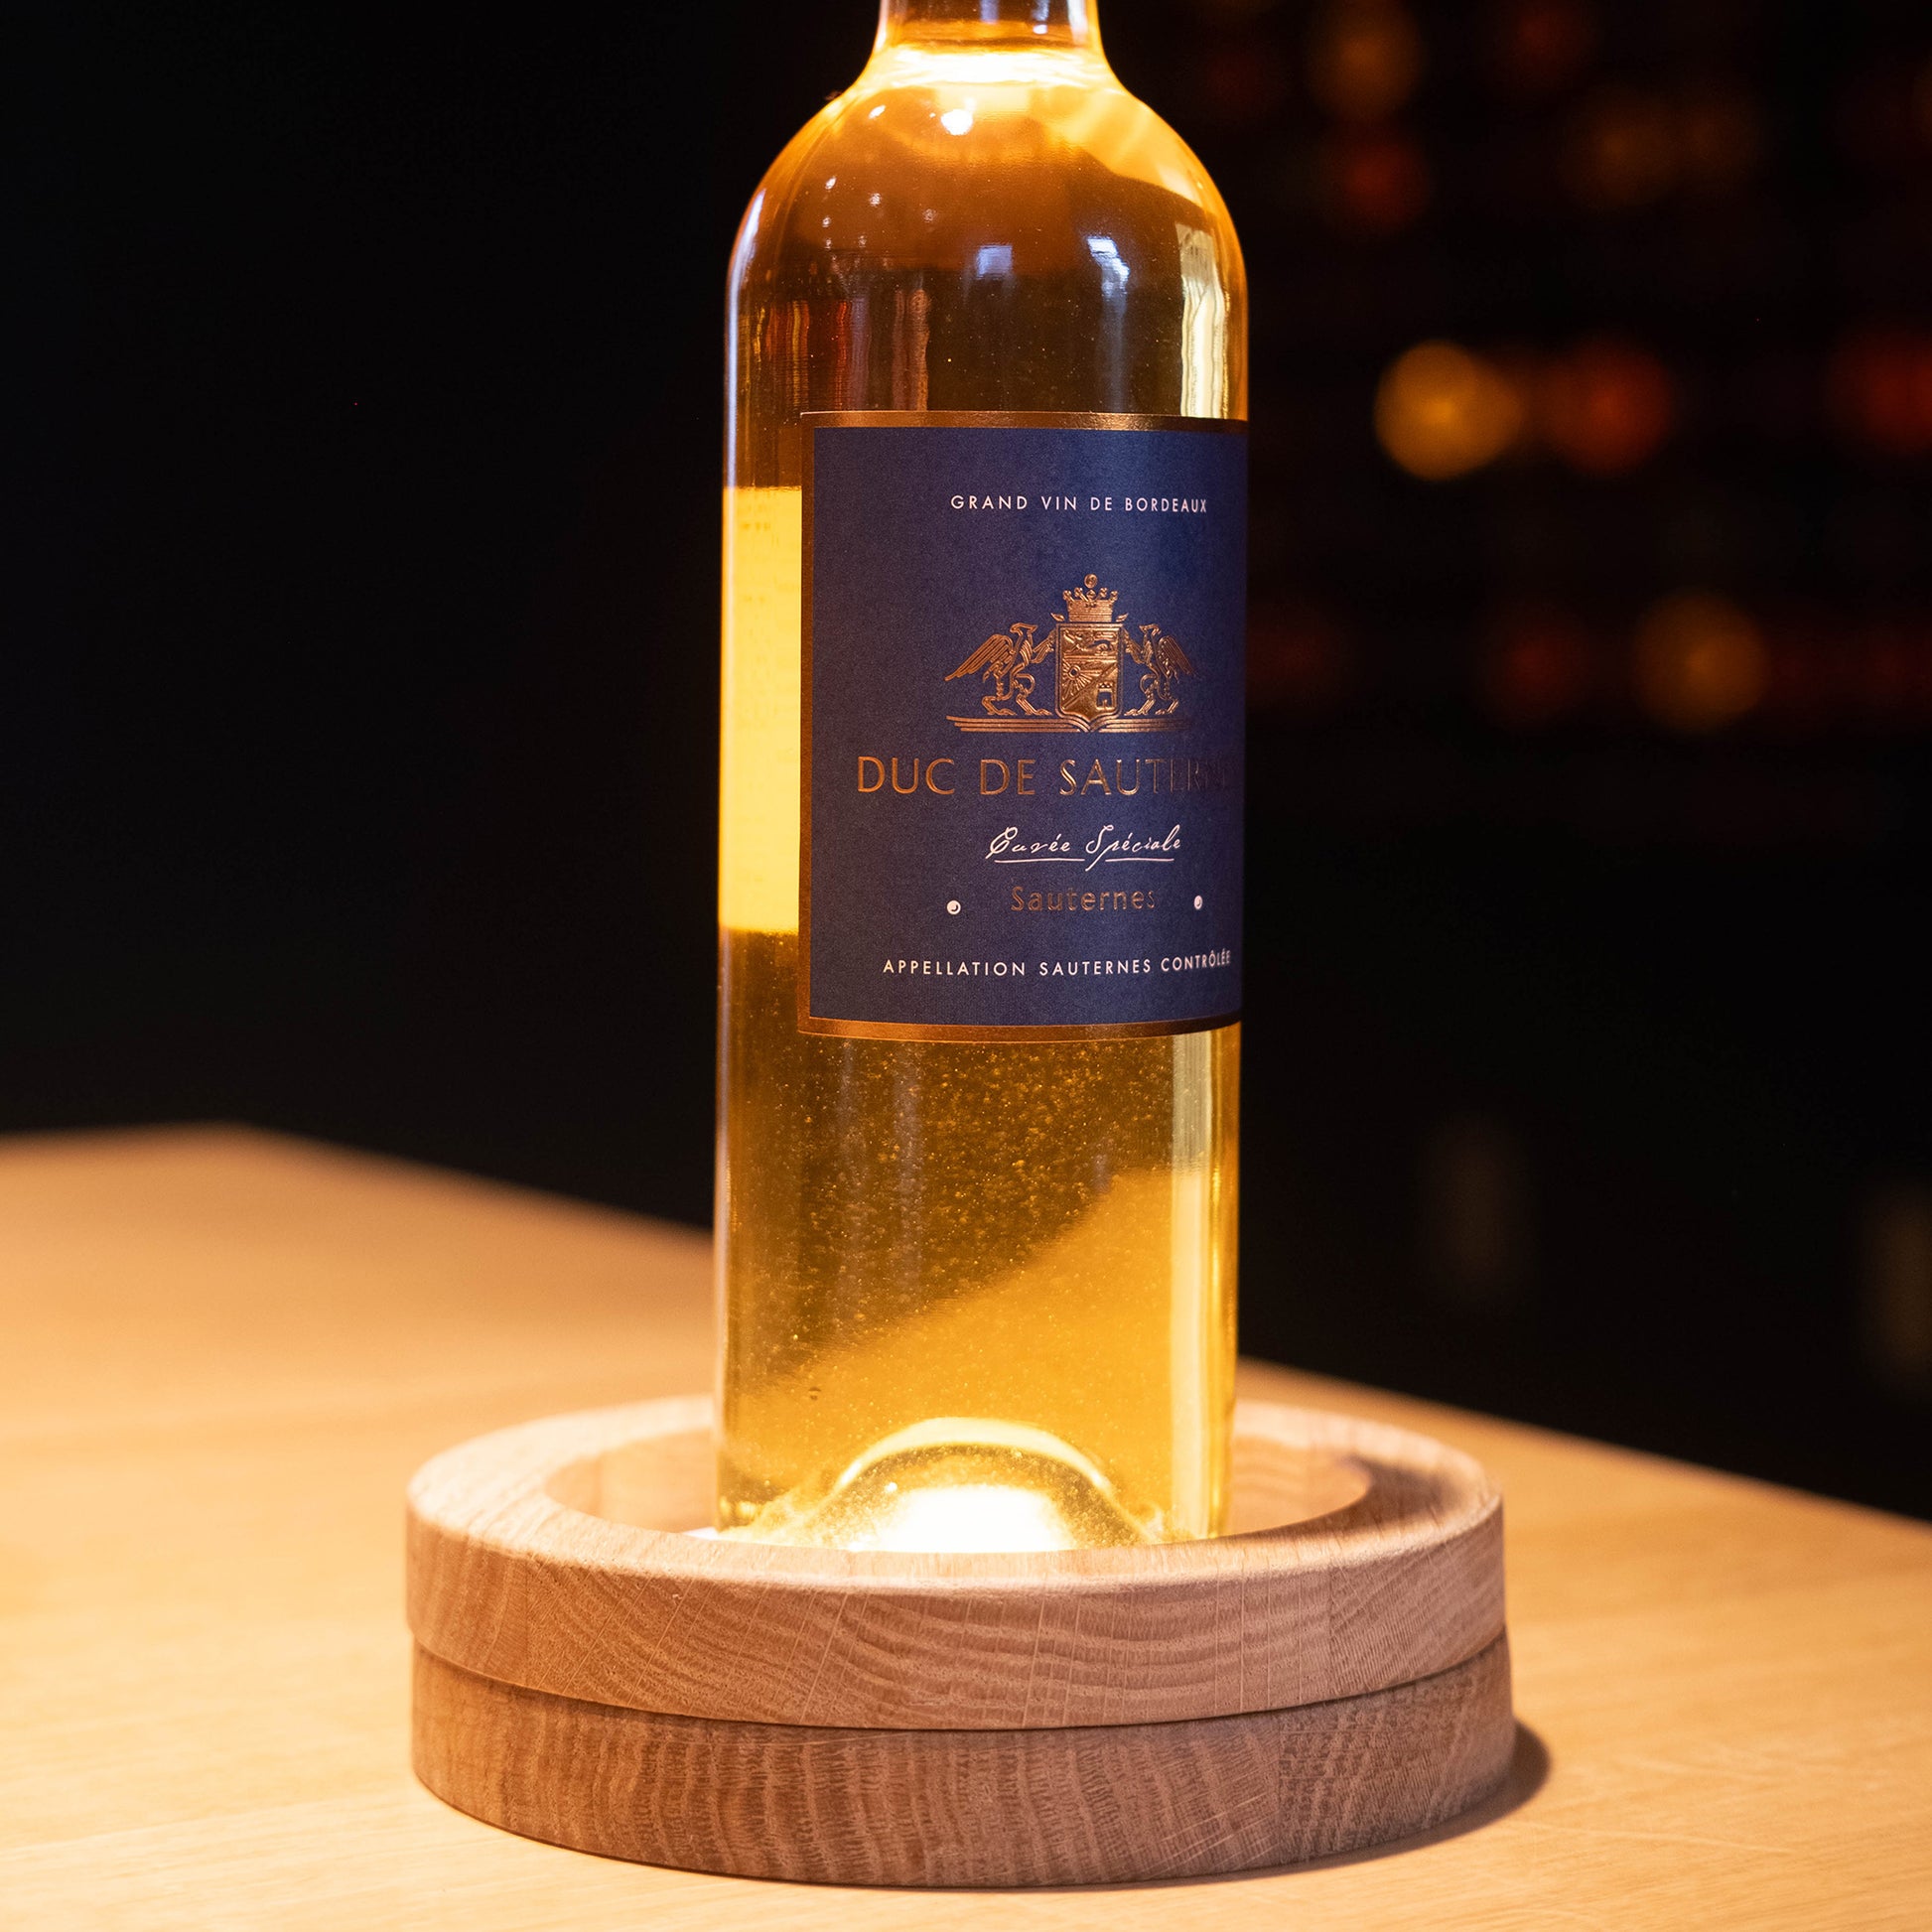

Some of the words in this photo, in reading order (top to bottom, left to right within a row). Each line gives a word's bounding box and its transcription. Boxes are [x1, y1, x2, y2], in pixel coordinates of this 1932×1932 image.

[950, 494, 1028, 510] GRAND
[1040, 495, 1077, 511] VIN
[1090, 496, 1113, 511] DE
[1124, 497, 1207, 513] BORDEAUX
[857, 756, 956, 795] DUC
[979, 759, 1035, 795] DE
[985, 826, 1071, 860] Cuvée
[1084, 824, 1181, 872] Spéciale
[1010, 886, 1156, 912] Sauternes
[882, 959, 1027, 977] APPELLATION
[1038, 958, 1151, 977] SAUTERNES
[1160, 947, 1231, 973] CONTRÔLÉE
